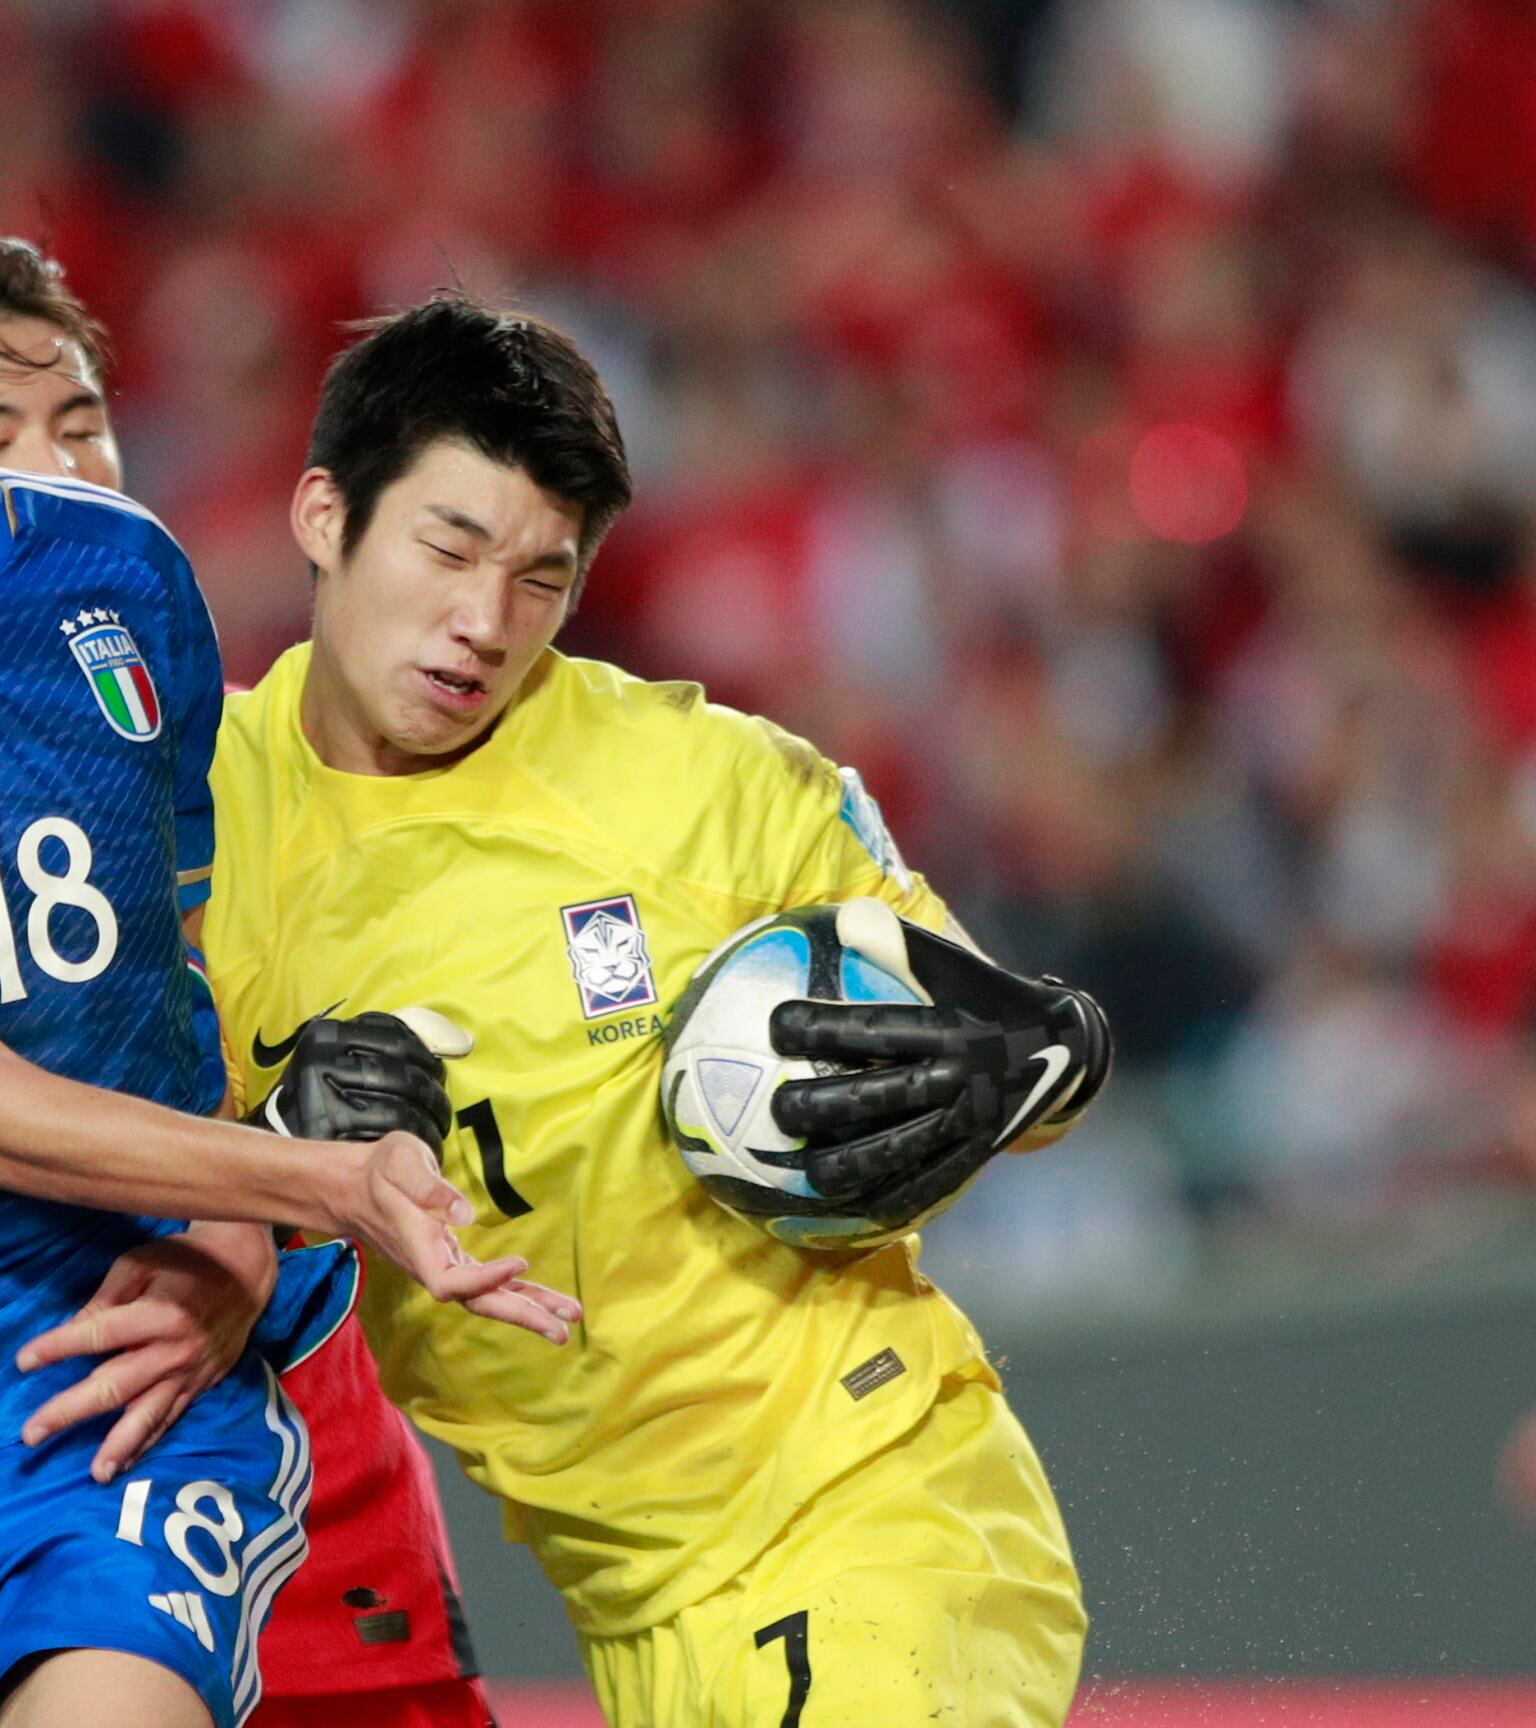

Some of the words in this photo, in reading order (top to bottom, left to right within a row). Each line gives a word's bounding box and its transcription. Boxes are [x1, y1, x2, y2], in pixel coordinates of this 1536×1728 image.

[77, 634, 135, 663] ITALIA
[587, 1014, 664, 1046] KOREA
[115, 1479, 244, 1597] 18
